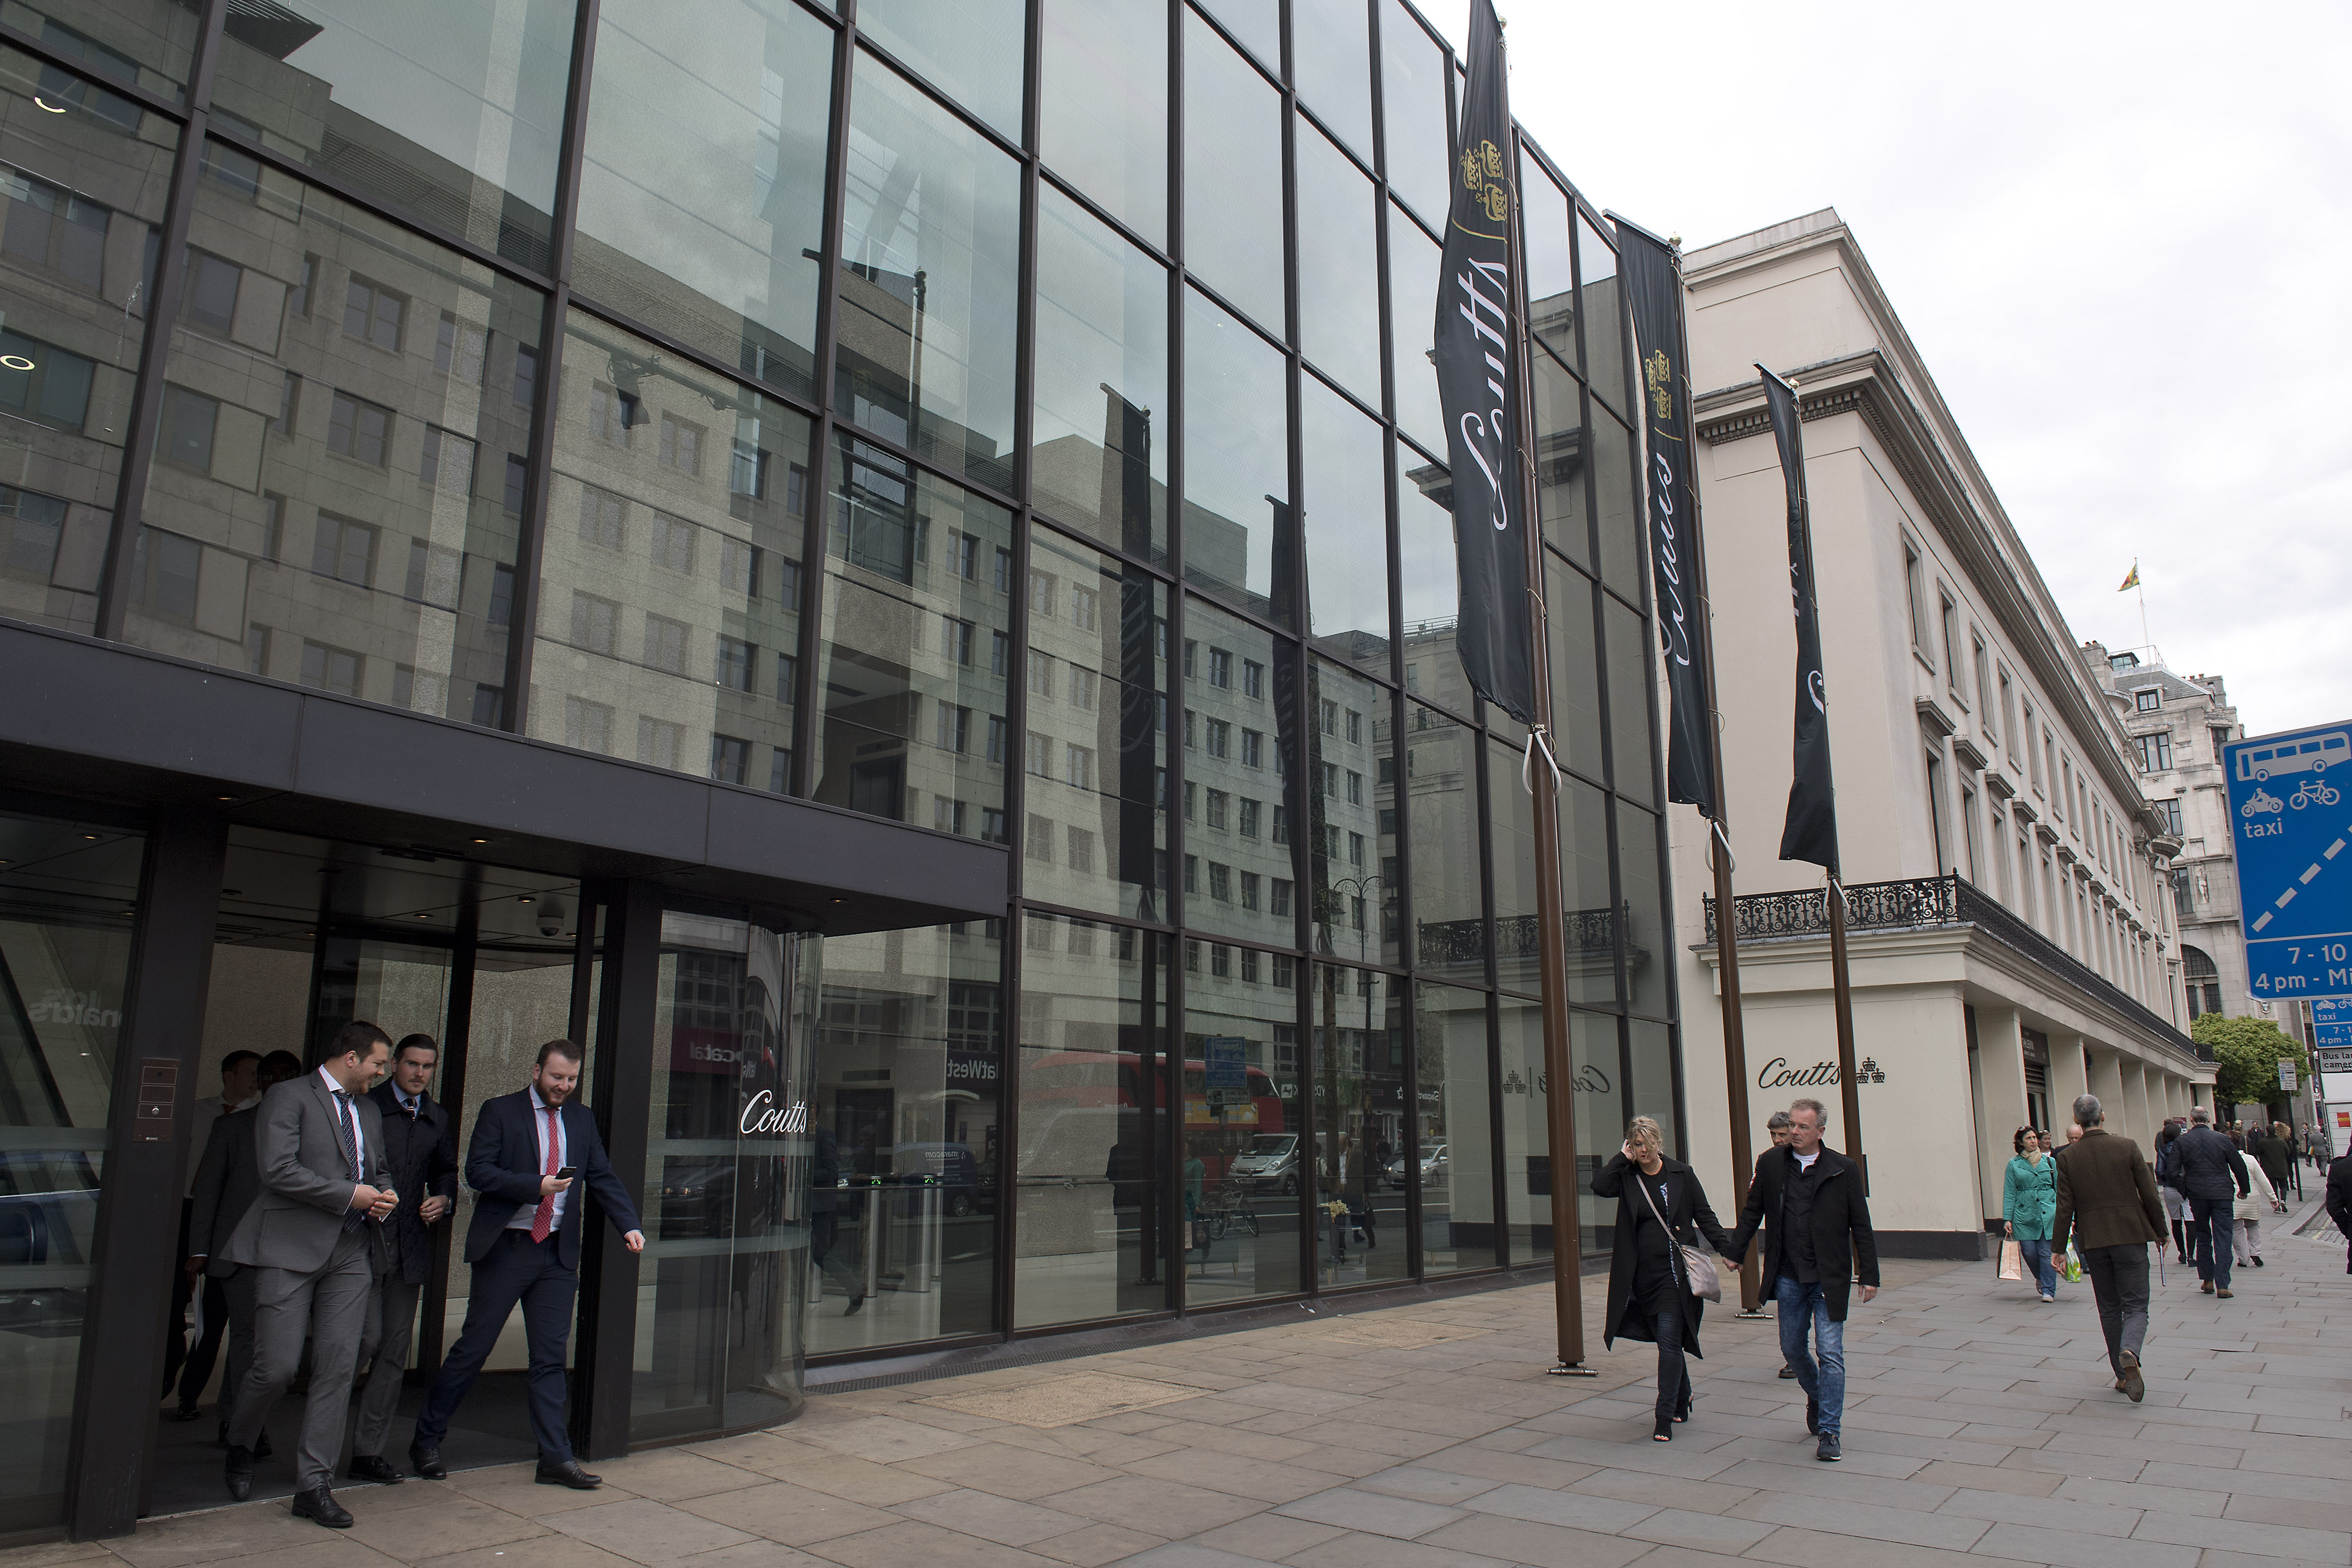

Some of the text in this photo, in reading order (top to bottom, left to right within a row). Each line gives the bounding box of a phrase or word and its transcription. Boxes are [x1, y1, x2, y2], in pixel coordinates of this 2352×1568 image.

[2243, 817, 2283, 838] taxi
[2287, 947, 2300, 964] 7
[2321, 944, 2347, 962] 10
[2317, 1012, 2336, 1021] taxi
[1758, 1057, 1840, 1089] Coutts
[740, 1089, 807, 1134] Coutts
